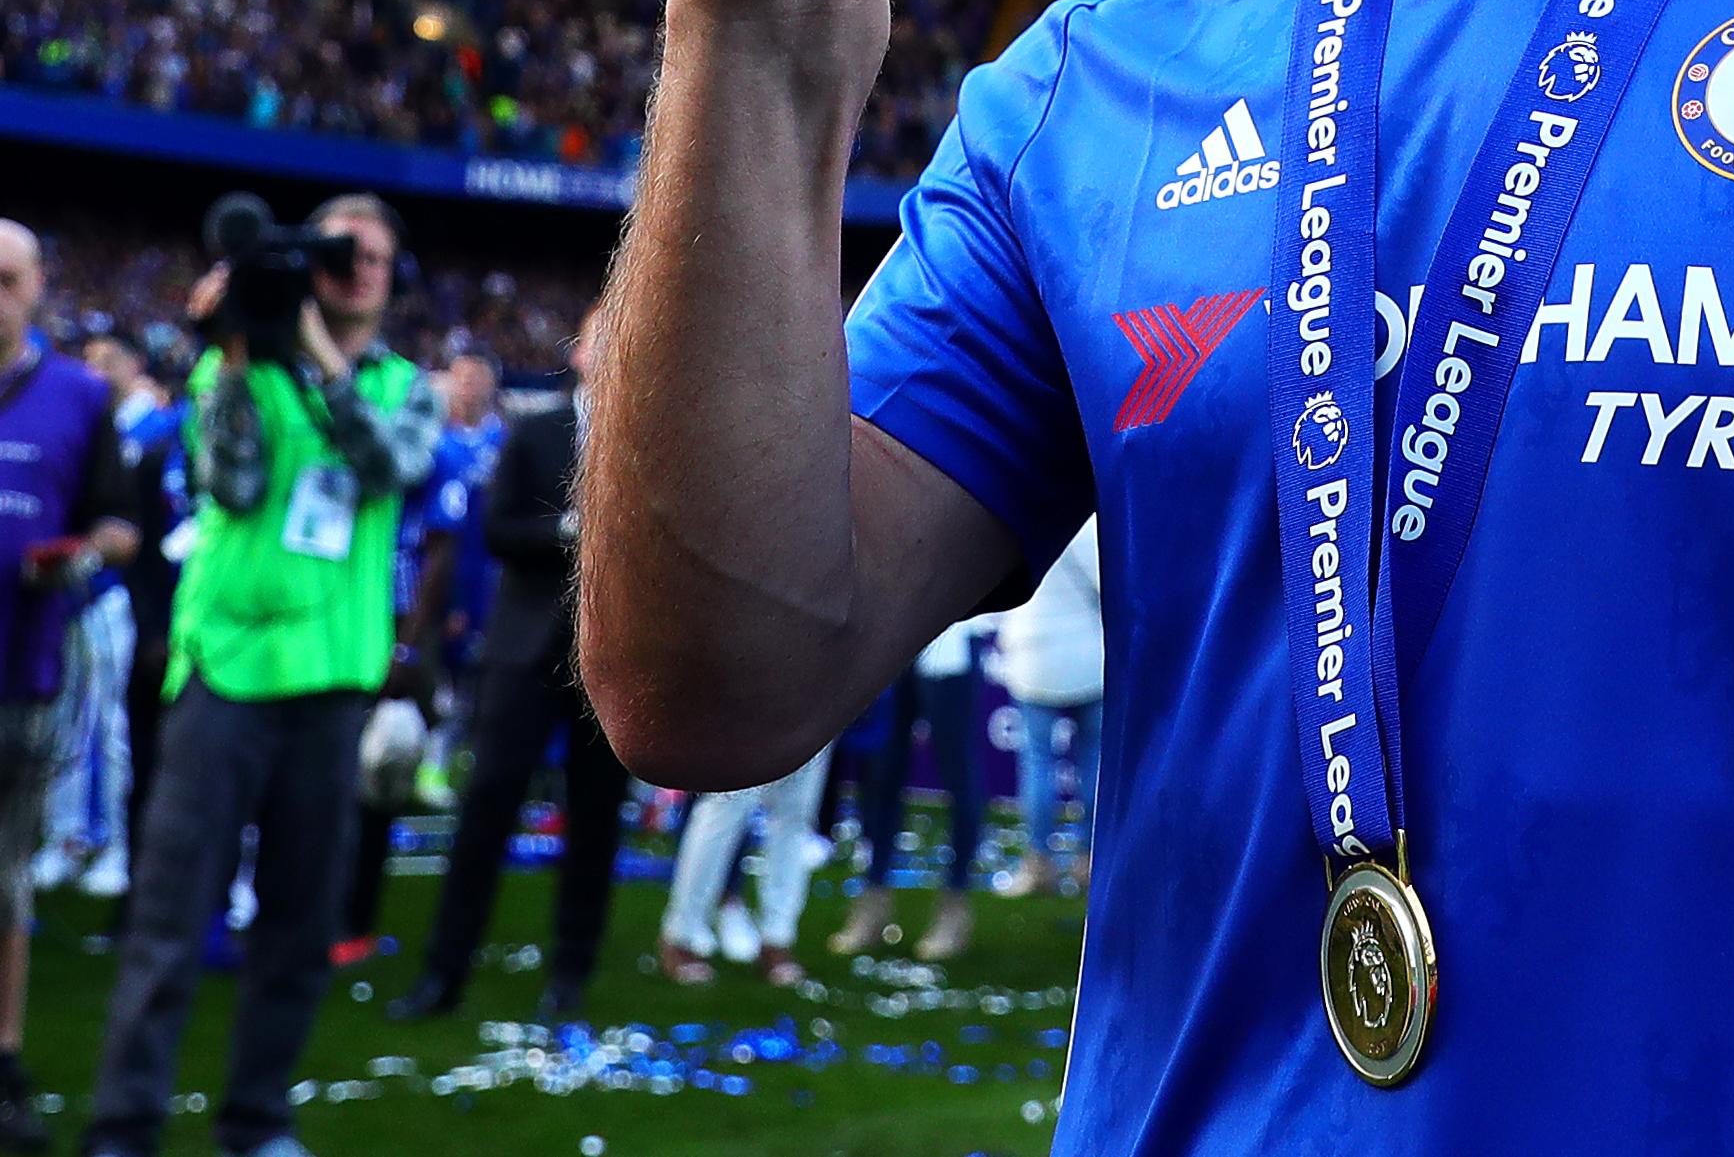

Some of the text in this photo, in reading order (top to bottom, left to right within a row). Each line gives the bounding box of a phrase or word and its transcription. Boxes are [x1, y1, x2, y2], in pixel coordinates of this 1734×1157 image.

[1155, 159, 1281, 211] adidas
[1286, 173, 1348, 376] League
[1392, 110, 1579, 542] Premier League
[1306, 478, 1352, 703] Premier
